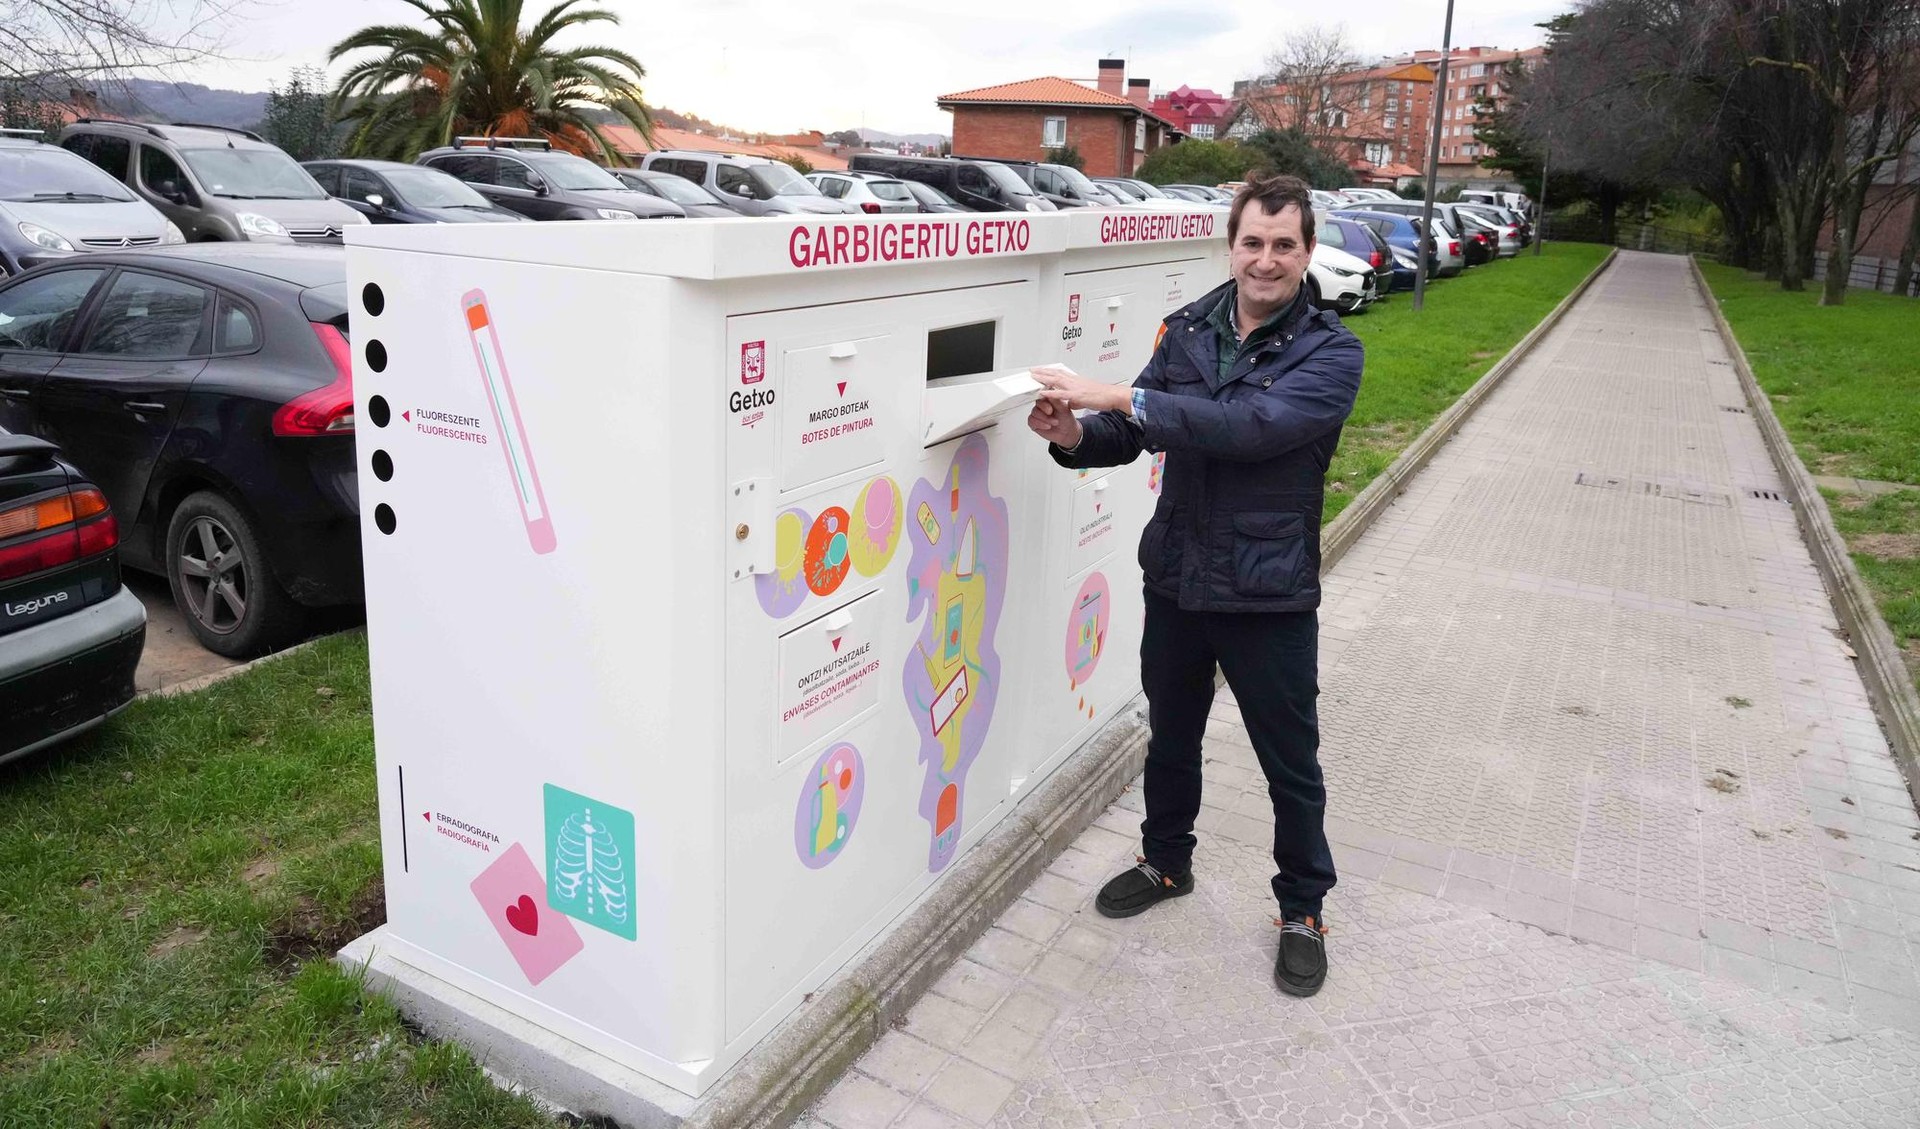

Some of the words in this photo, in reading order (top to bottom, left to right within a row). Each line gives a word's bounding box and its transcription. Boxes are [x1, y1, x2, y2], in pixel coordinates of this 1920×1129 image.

[1100, 215, 1179, 244] GARBIGERTU
[1181, 213, 1214, 238] GETXO
[789, 222, 960, 268] GARBIGERTU
[966, 219, 1030, 255] GETXO
[1062, 325, 1082, 341] Getxo
[729, 388, 775, 413] Getxo
[809, 407, 839, 423] MARGO
[840, 400, 869, 416] BOTEAK
[416, 408, 480, 428] FLUORESZENTE
[802, 428, 829, 445] BOTES
[830, 425, 841, 438] DE
[842, 417, 874, 434] PINTURA
[417, 423, 487, 445] FLUORESCENTES
[5, 591, 68, 616] Laguna
[798, 668, 822, 689] ONTZI
[823, 642, 870, 676] KUTSATZAILE
[783, 694, 820, 722] ENVASES
[820, 659, 880, 700] CONTAMINANTES
[436, 812, 500, 844] ERRADIOGRAFIA
